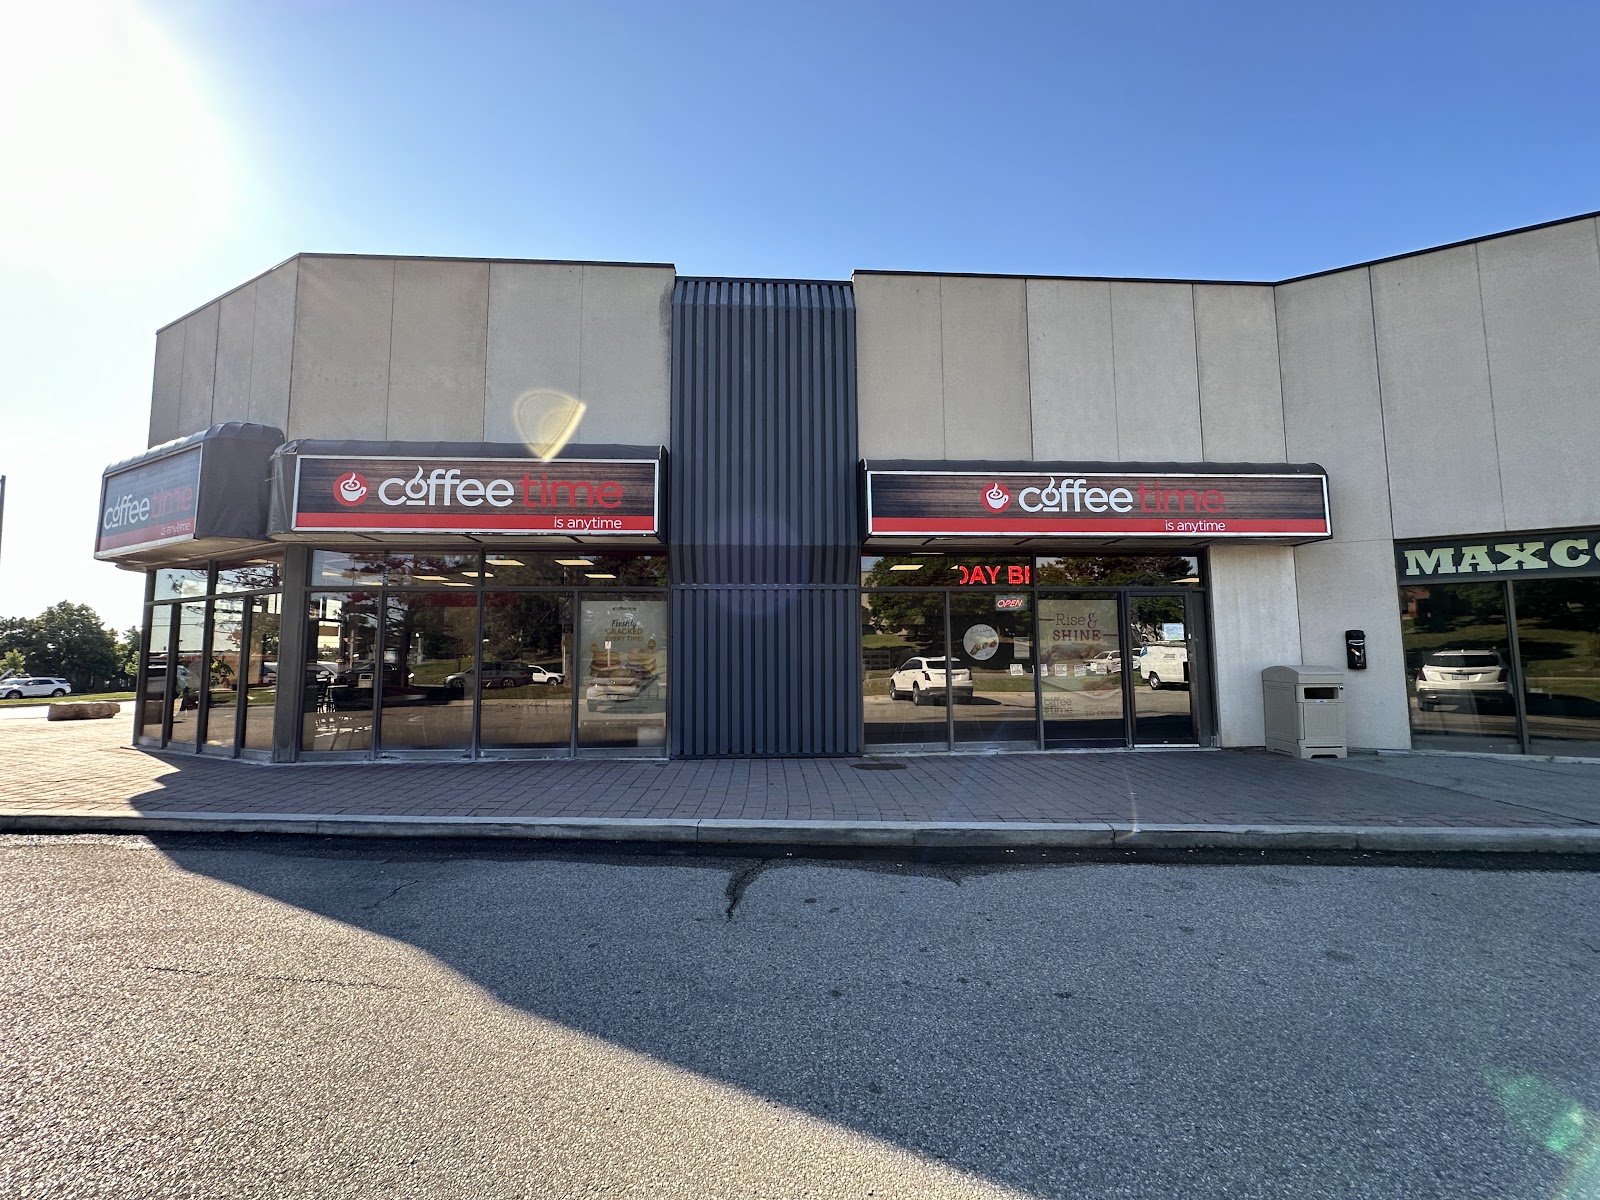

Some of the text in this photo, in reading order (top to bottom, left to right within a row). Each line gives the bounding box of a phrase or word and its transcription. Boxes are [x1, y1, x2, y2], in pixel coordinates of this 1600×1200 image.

[378, 465, 623, 508] coffee time
[1018, 476, 1225, 513] coffee time
[103, 486, 193, 530] coffee time
[166, 521, 191, 537] anytime
[553, 516, 622, 531] is anytime
[1165, 519, 1226, 533] is anytime
[1403, 538, 1600, 576] MAXC
[997, 599, 1023, 608] OPEN
[611, 619, 637, 630] Freshly
[1055, 613, 1099, 629] Rise &
[1052, 630, 1101, 642] SHINE
[1043, 697, 1072, 706] coffee
